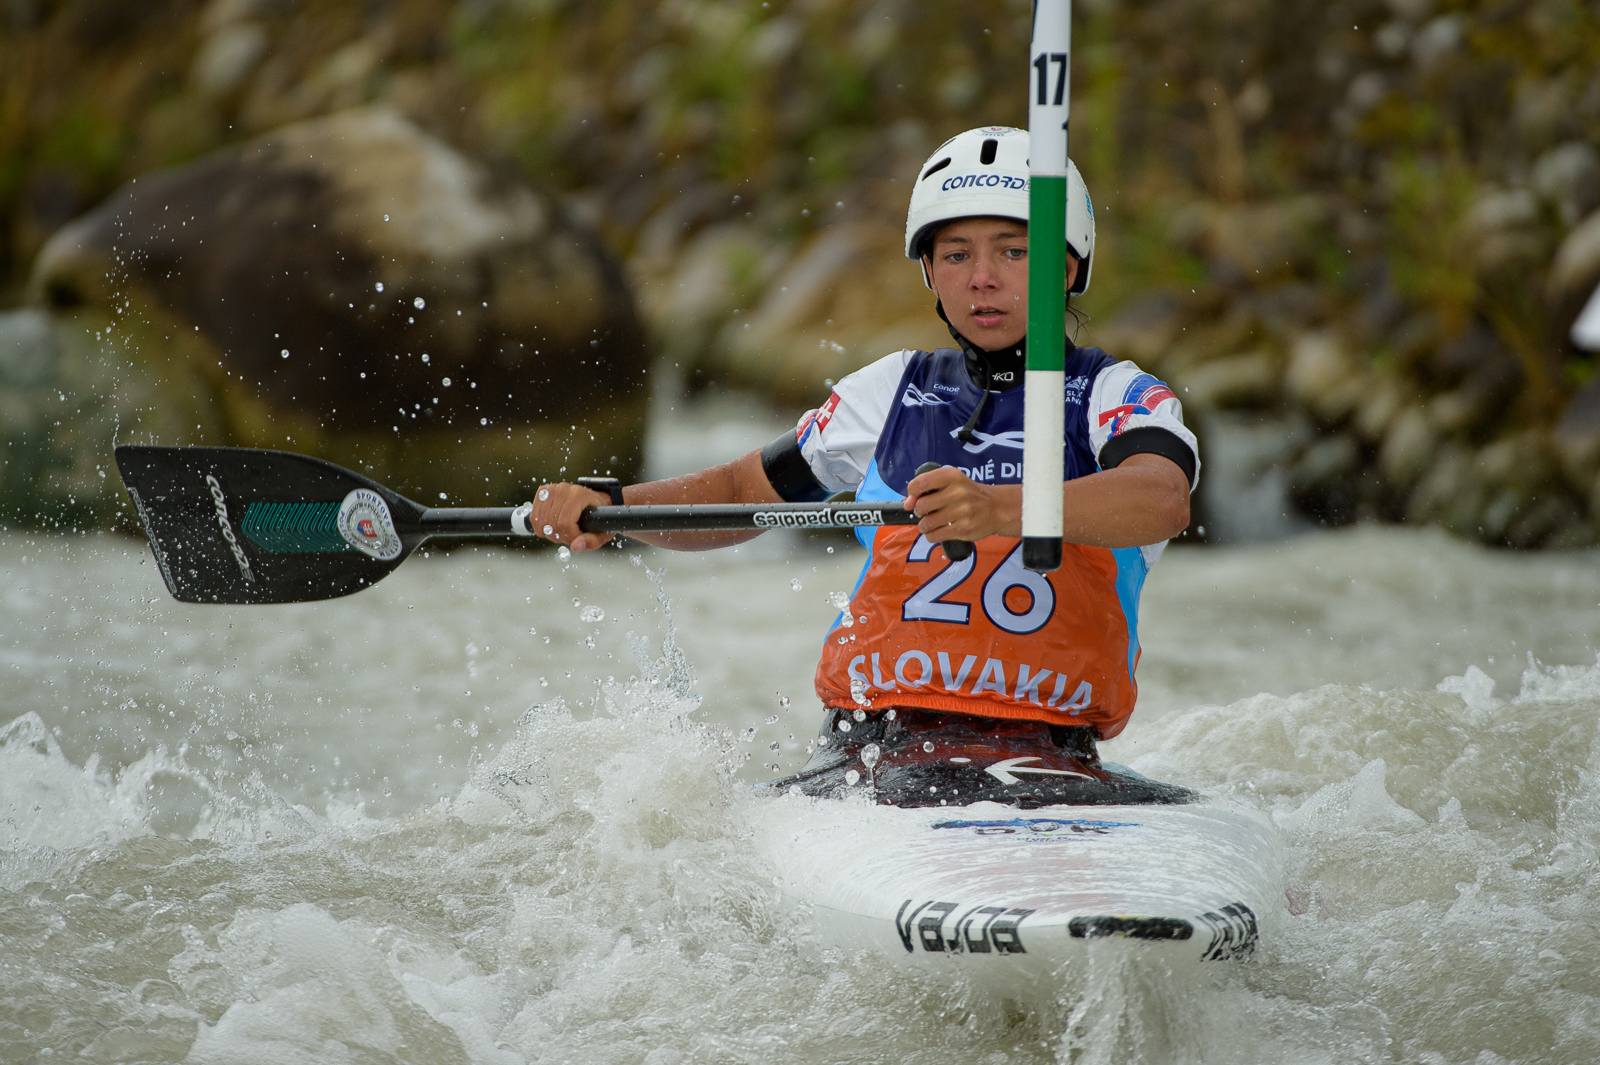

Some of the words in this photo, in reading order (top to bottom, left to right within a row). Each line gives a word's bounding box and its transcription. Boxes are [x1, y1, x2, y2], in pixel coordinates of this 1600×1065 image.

[1033, 52, 1068, 106] 17
[753, 508, 832, 528] paddles
[900, 532, 1056, 636] 26
[847, 649, 1093, 716] SLOVAKIA
